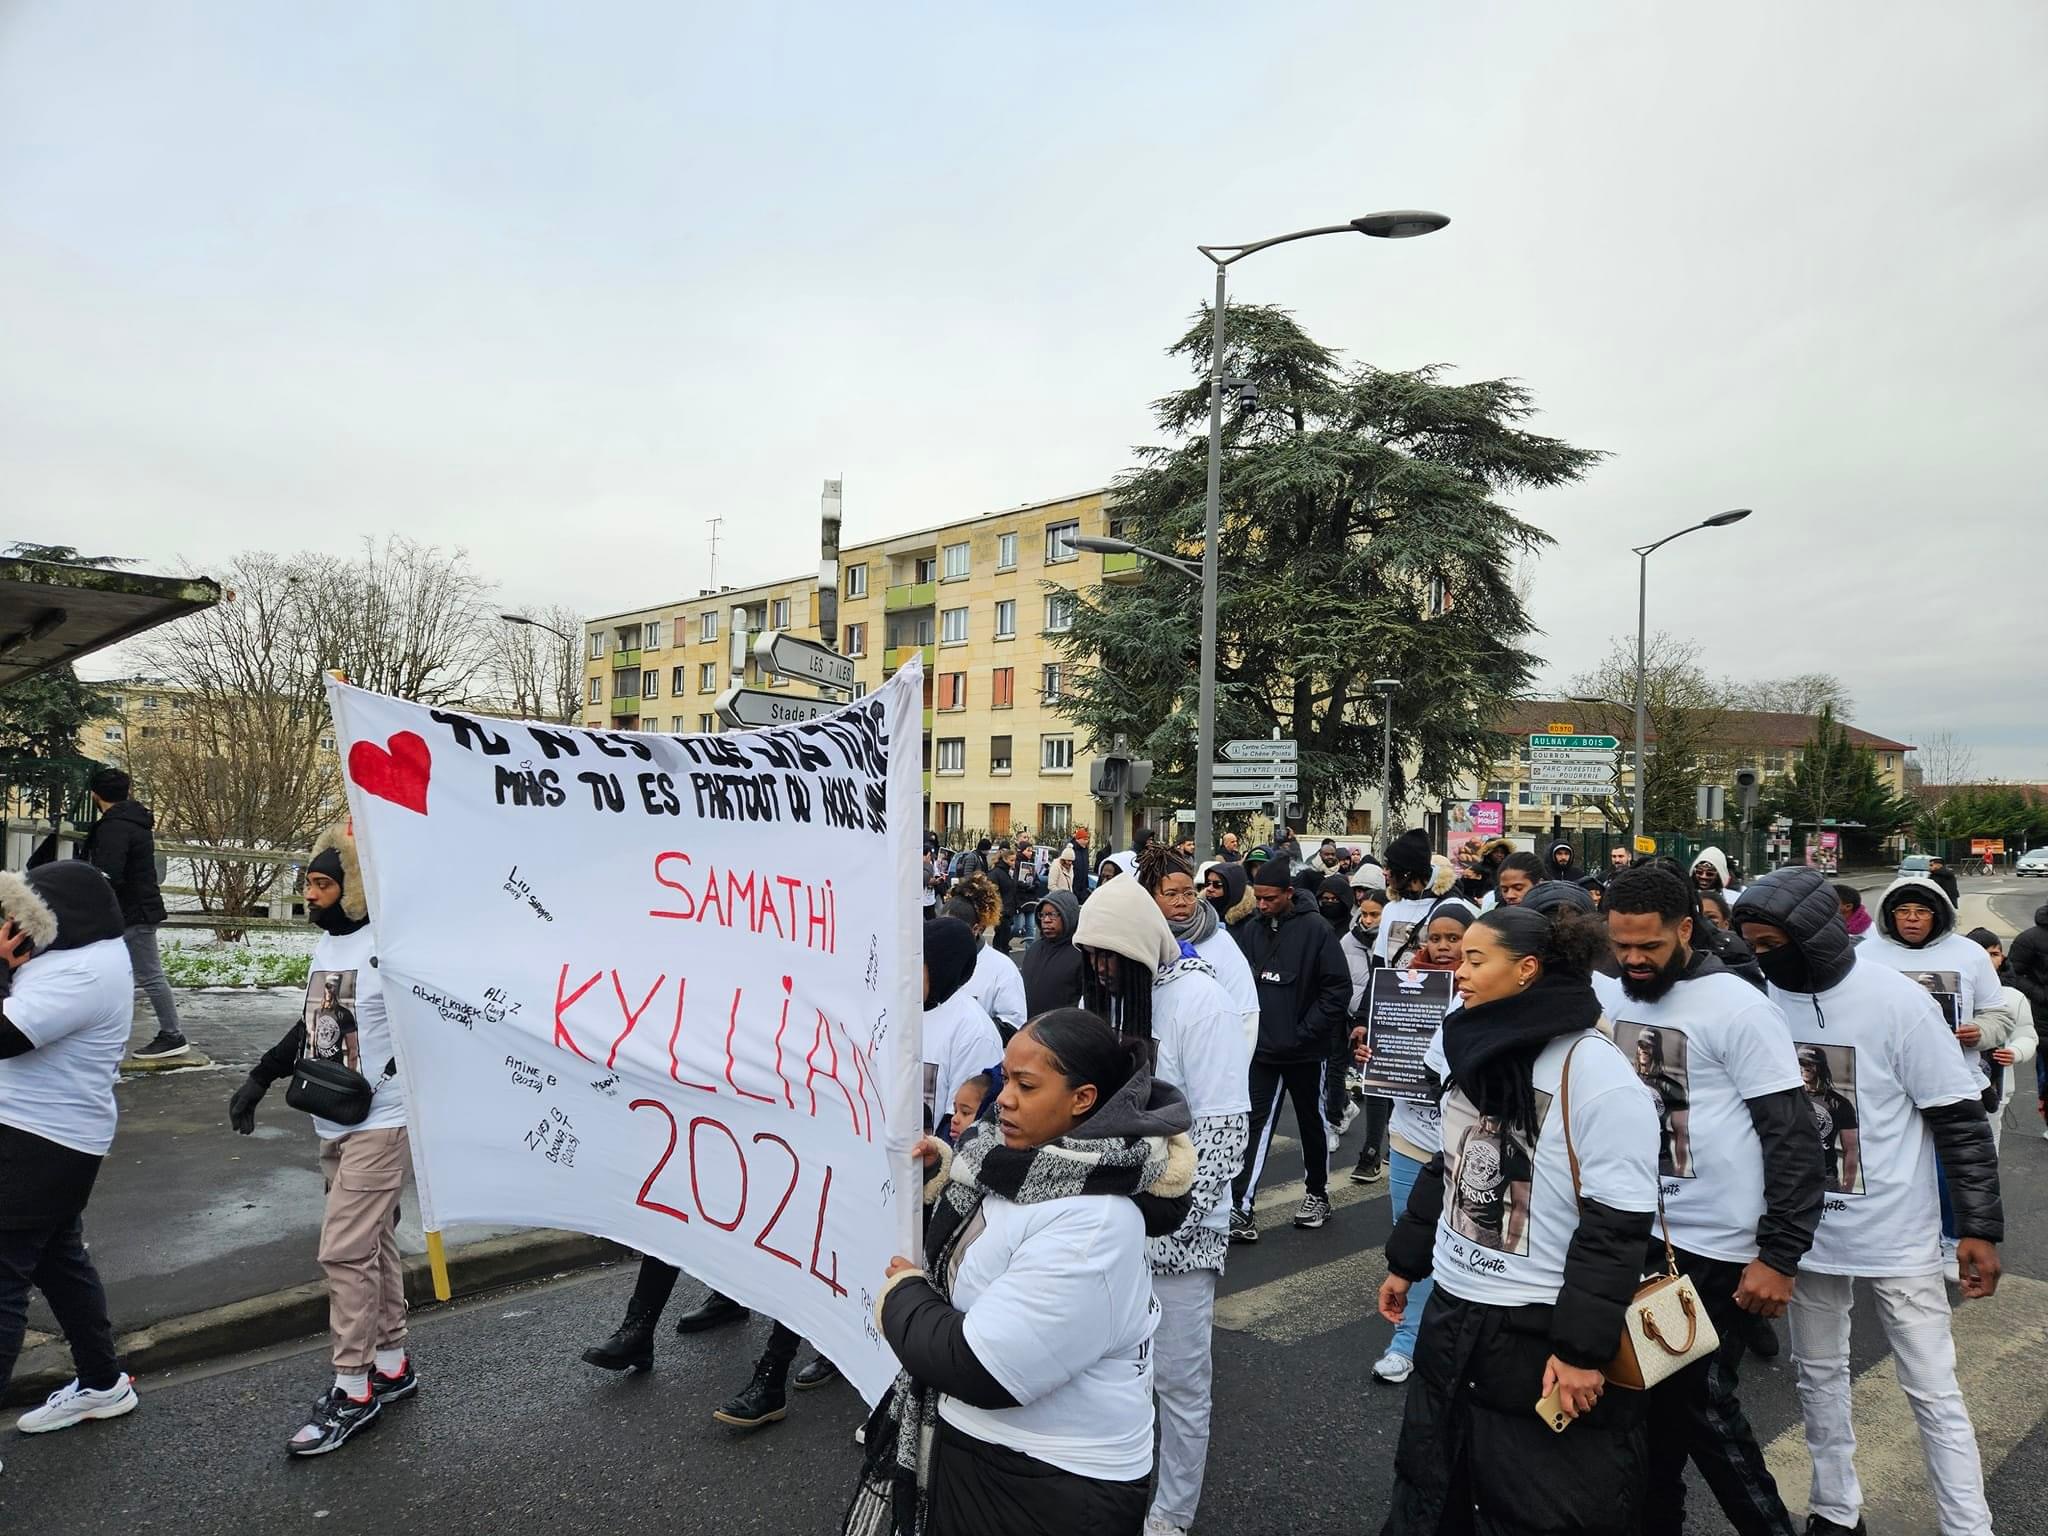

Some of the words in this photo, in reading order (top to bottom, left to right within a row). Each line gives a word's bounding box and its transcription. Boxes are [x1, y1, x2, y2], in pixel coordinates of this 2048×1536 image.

[809, 654, 823, 673] LES
[829, 661, 834, 679] 7
[836, 663, 851, 683] ILES
[771, 703, 805, 722] Stade
[430, 709, 511, 756] TU
[1534, 737, 1567, 746] AULNAY
[1582, 738, 1604, 747] BOIS
[1559, 772, 1599, 780] POUDRERIE
[1563, 765, 1602, 773] FORESTIER
[1262, 781, 1271, 789] La
[1273, 781, 1294, 789] Poste
[577, 771, 626, 814] TU
[637, 772, 681, 817] ES
[689, 772, 781, 822] PARTOUT
[818, 775, 865, 830] NOUS
[1261, 969, 1280, 982] FILA
[546, 1074, 557, 1086] B
[550, 1106, 563, 1122] B
[562, 1115, 573, 1130] T
[628, 1098, 848, 1298] 2024
[1460, 1180, 1499, 1204] ERSACE
